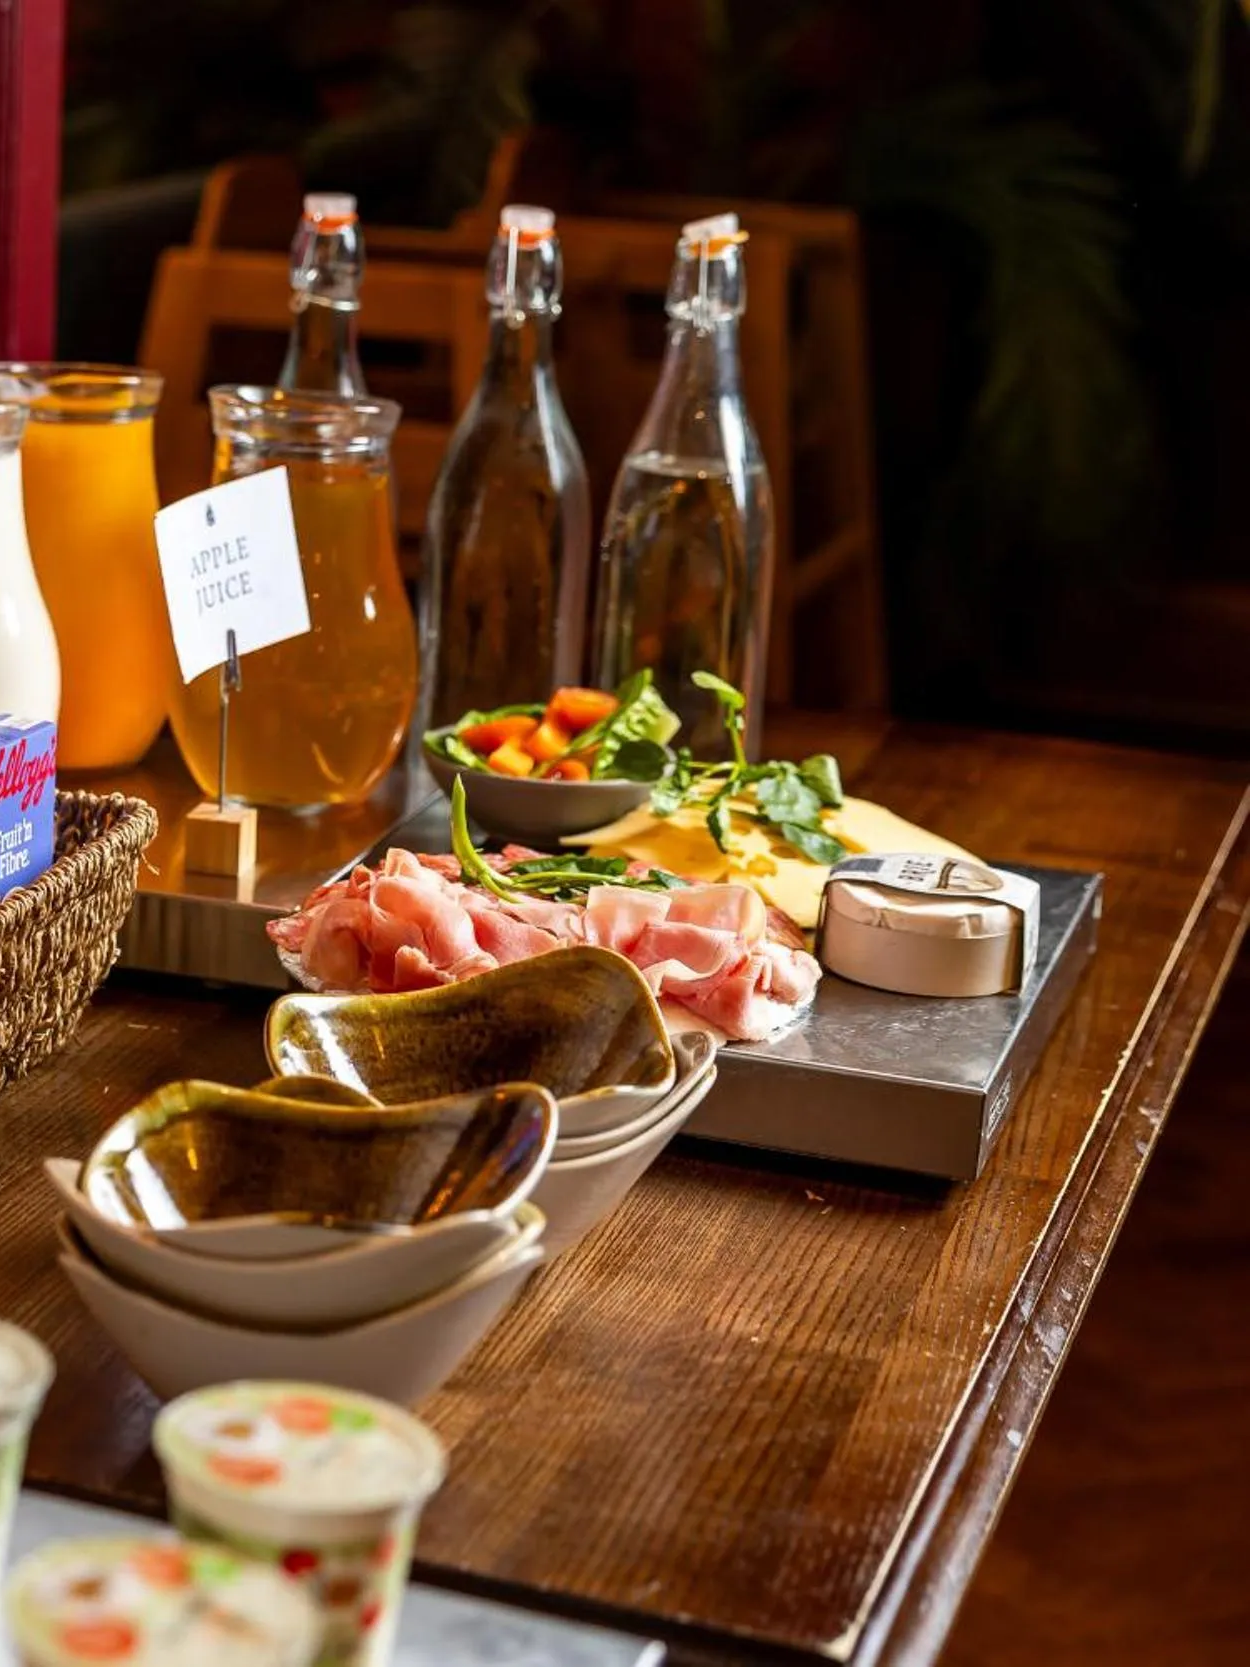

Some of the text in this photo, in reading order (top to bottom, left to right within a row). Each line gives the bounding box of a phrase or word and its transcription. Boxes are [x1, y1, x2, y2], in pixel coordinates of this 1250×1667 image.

[190, 536, 249, 579] APPLE
[196, 571, 253, 616] JUICE
[0, 849, 30, 879] Fibre
